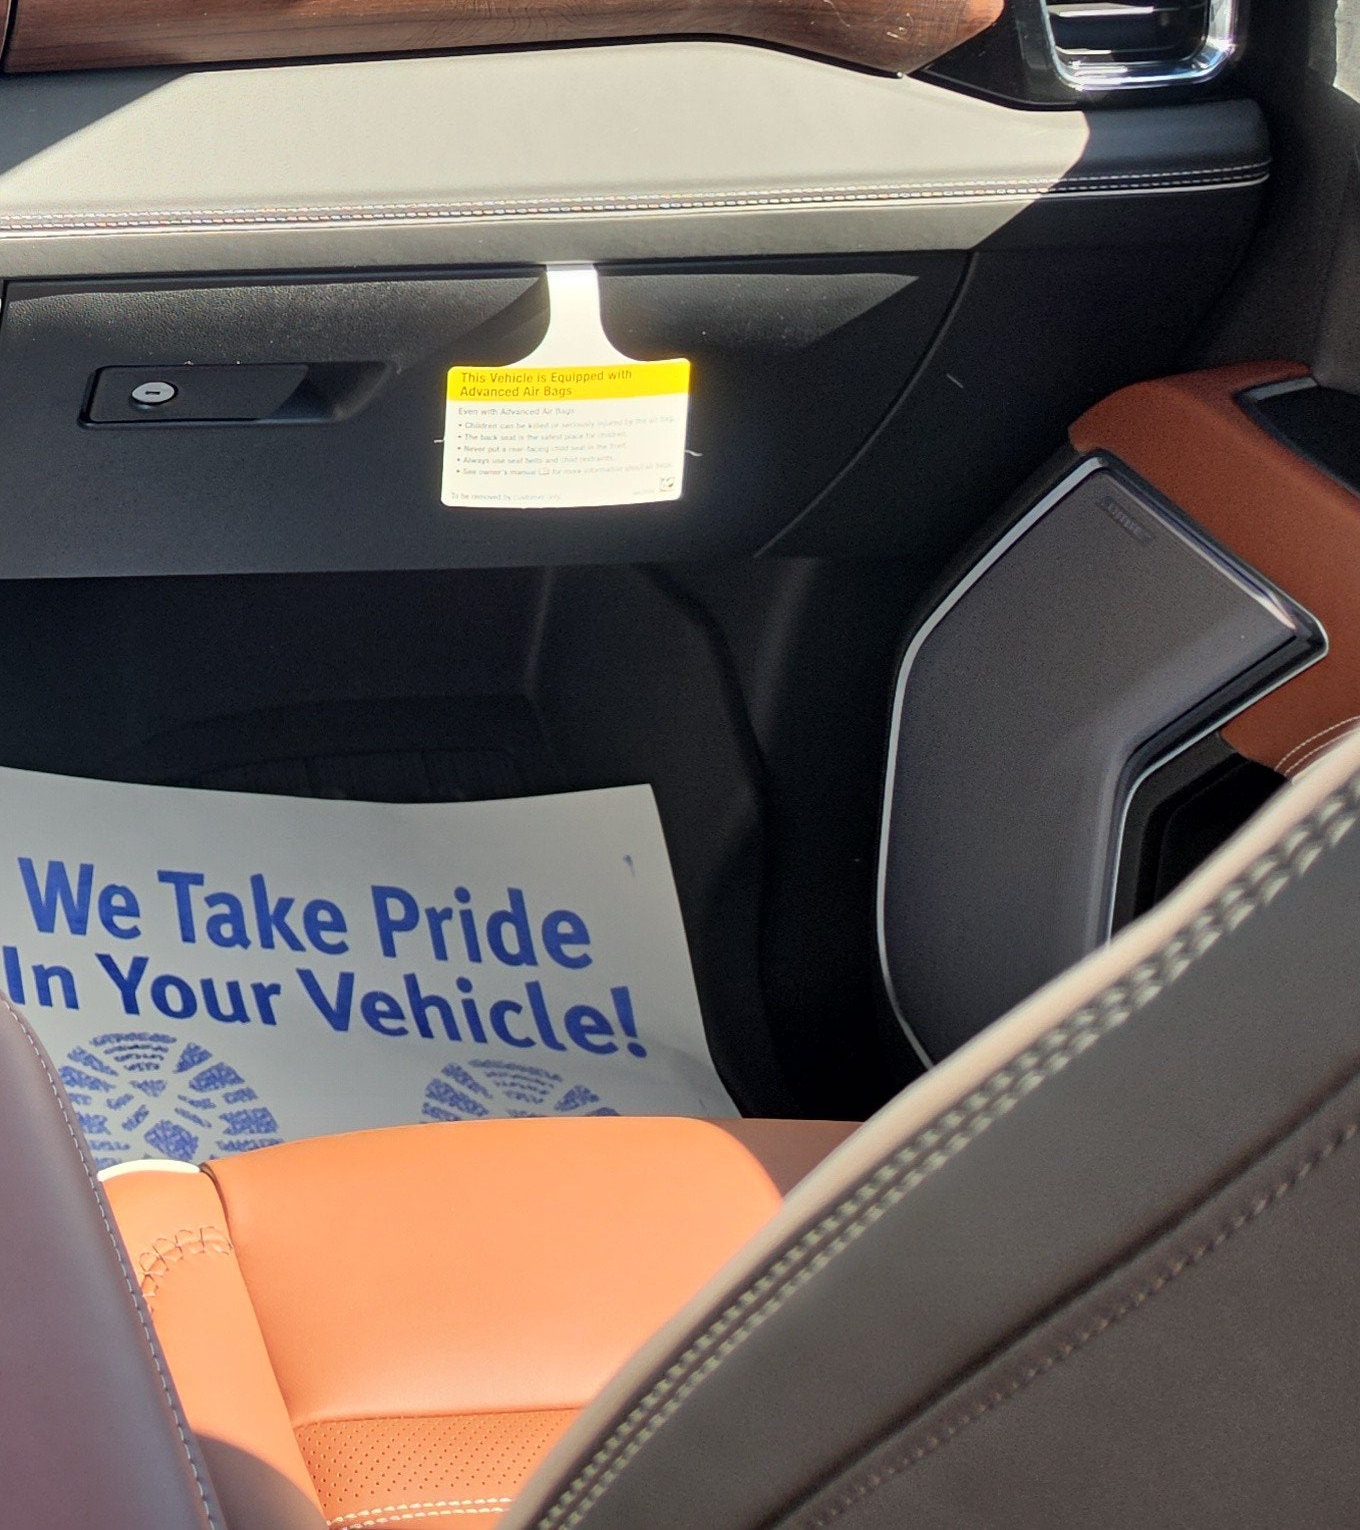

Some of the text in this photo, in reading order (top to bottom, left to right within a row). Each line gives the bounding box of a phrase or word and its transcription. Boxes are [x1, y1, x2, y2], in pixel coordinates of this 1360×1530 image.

[460, 386, 573, 399] Advanced Air Bags
[461, 369, 632, 384] This Vehicle is Equipped with
[18, 856, 593, 970] We Take Pride
[2, 945, 649, 1059] In Your Vehicle!
